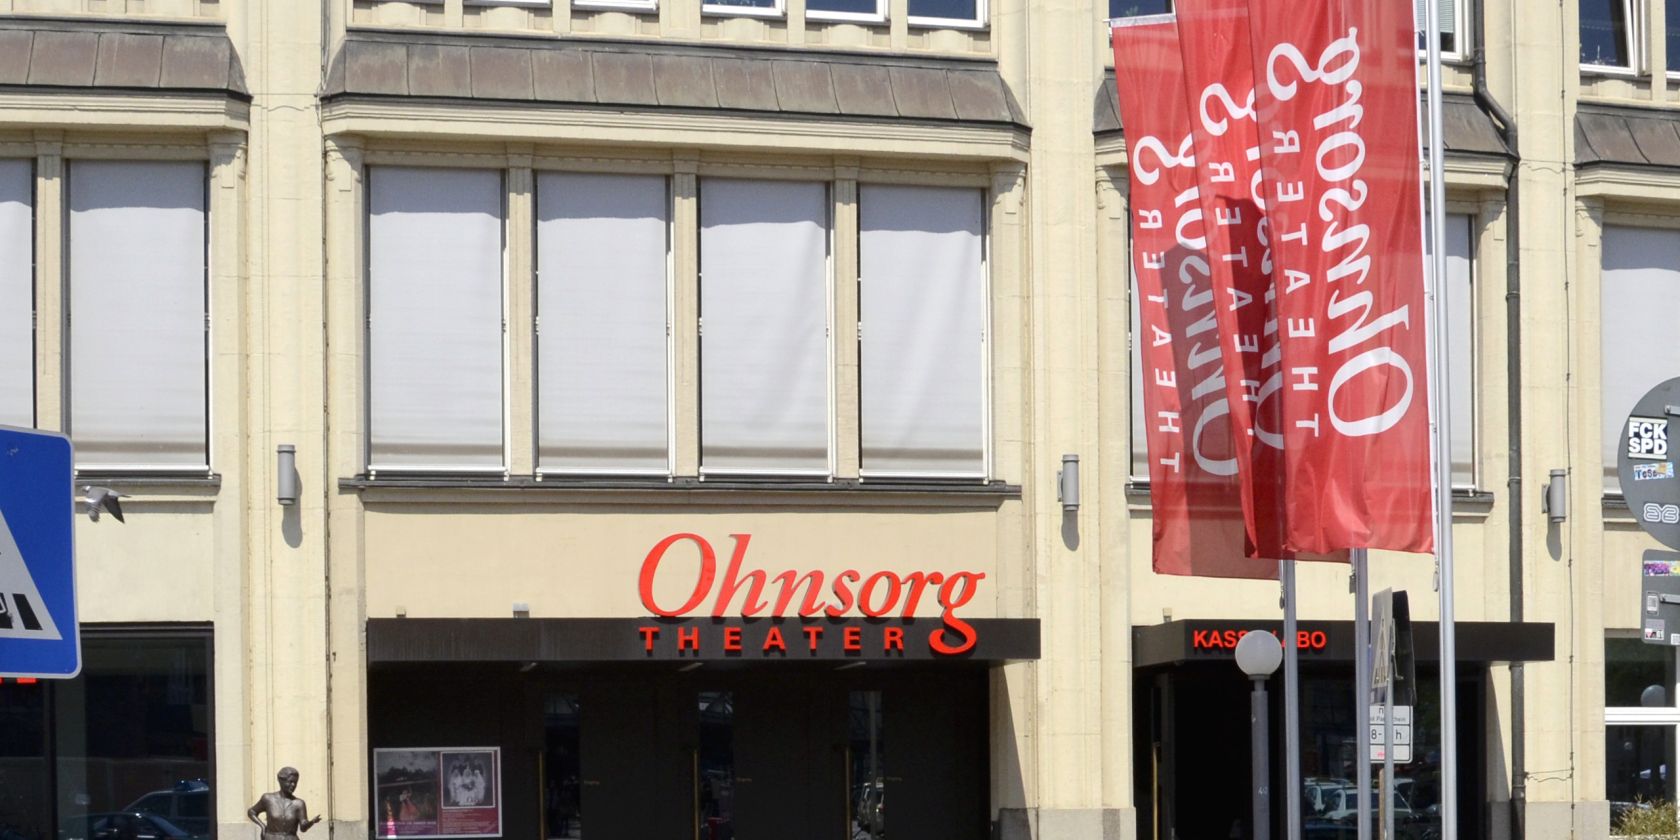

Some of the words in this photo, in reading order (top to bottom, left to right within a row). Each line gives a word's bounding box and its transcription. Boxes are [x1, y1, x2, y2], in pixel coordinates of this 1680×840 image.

[1629, 421, 1668, 440] FCK
[1628, 437, 1668, 455] SPD
[638, 532, 986, 656] Ohnsorg
[638, 626, 906, 652] THEATER
